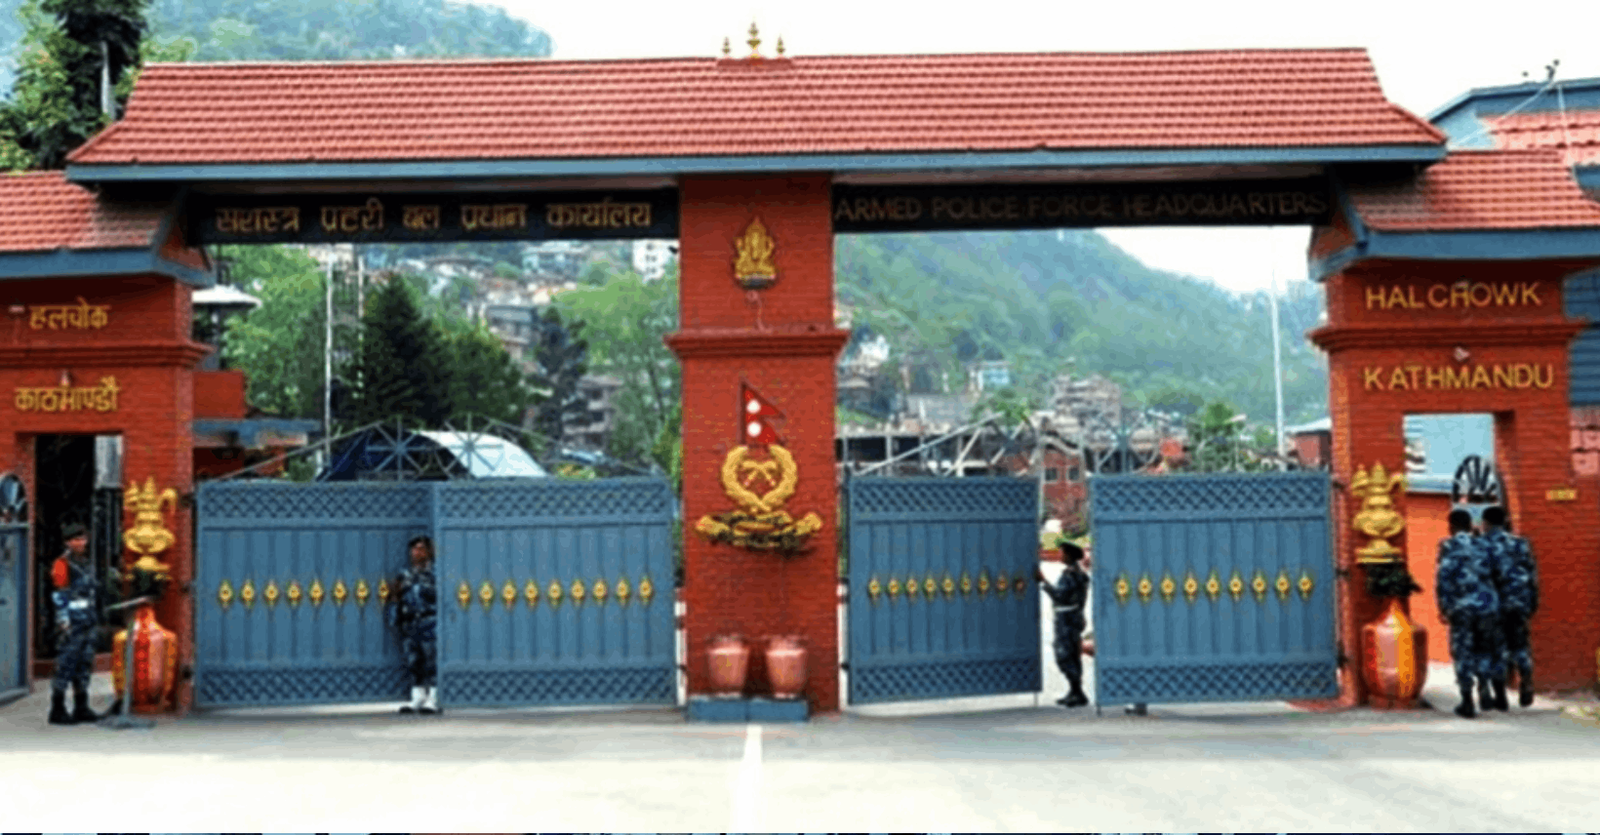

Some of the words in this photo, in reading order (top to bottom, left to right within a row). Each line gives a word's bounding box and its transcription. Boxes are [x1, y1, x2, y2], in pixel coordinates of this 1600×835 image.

[403, 205, 440, 230] बल
[546, 197, 652, 228] कार्यालय
[834, 195, 922, 221] ARMED
[931, 195, 1020, 220] POLICE
[1028, 194, 1114, 218] FORCE
[1122, 191, 1328, 217] HEADQUARTERS
[1365, 281, 1542, 310] HALCHOWK
[1364, 363, 1554, 391] KATHMANDU
